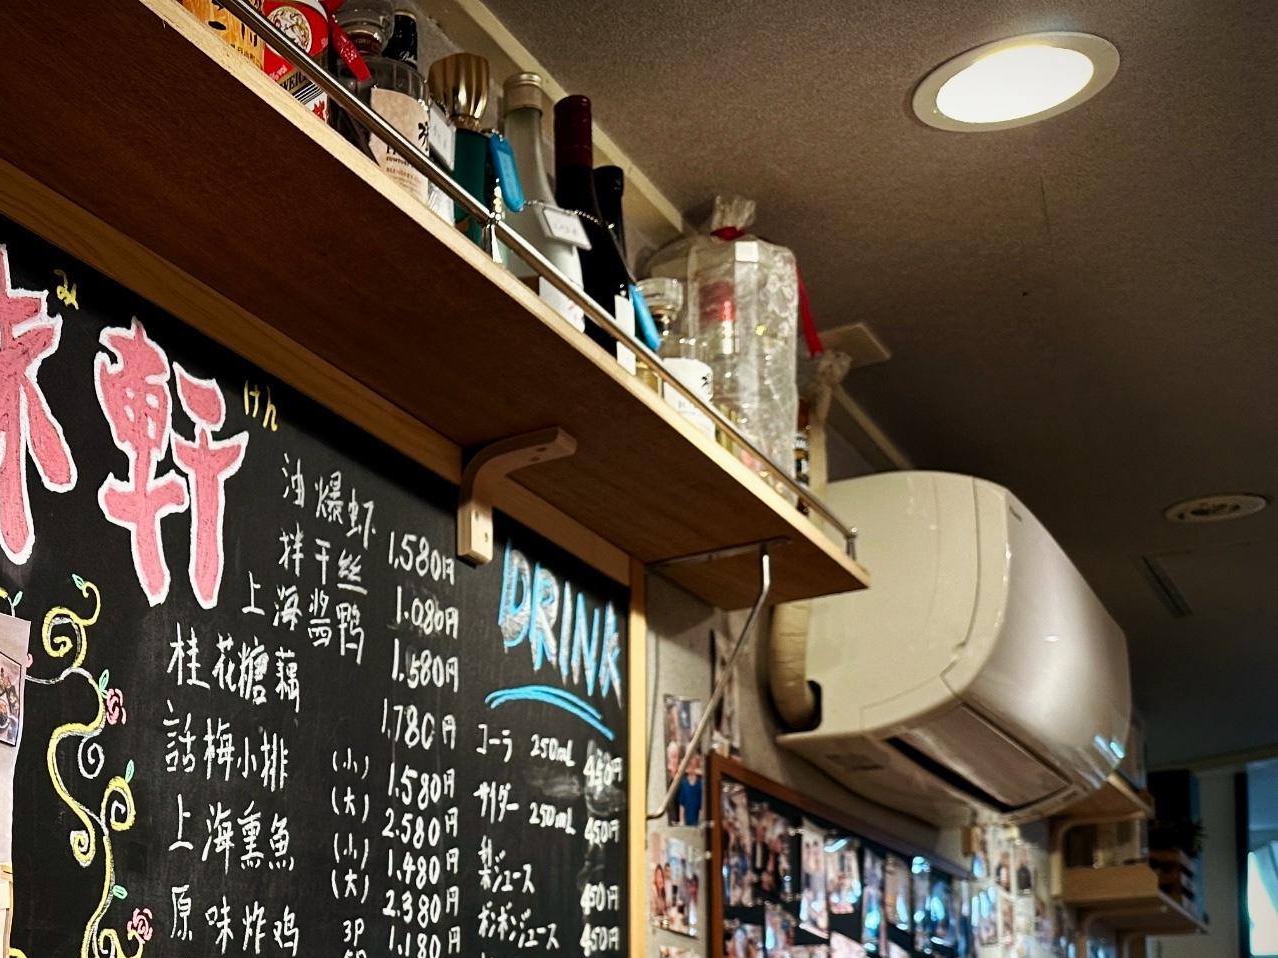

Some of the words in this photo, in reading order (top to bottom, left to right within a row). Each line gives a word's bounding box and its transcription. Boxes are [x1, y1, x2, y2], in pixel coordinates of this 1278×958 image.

[243, 380, 278, 432] けん
[498, 540, 622, 703] DRINK
[476, 724, 513, 762] コーラ
[473, 781, 519, 824] サイダー
